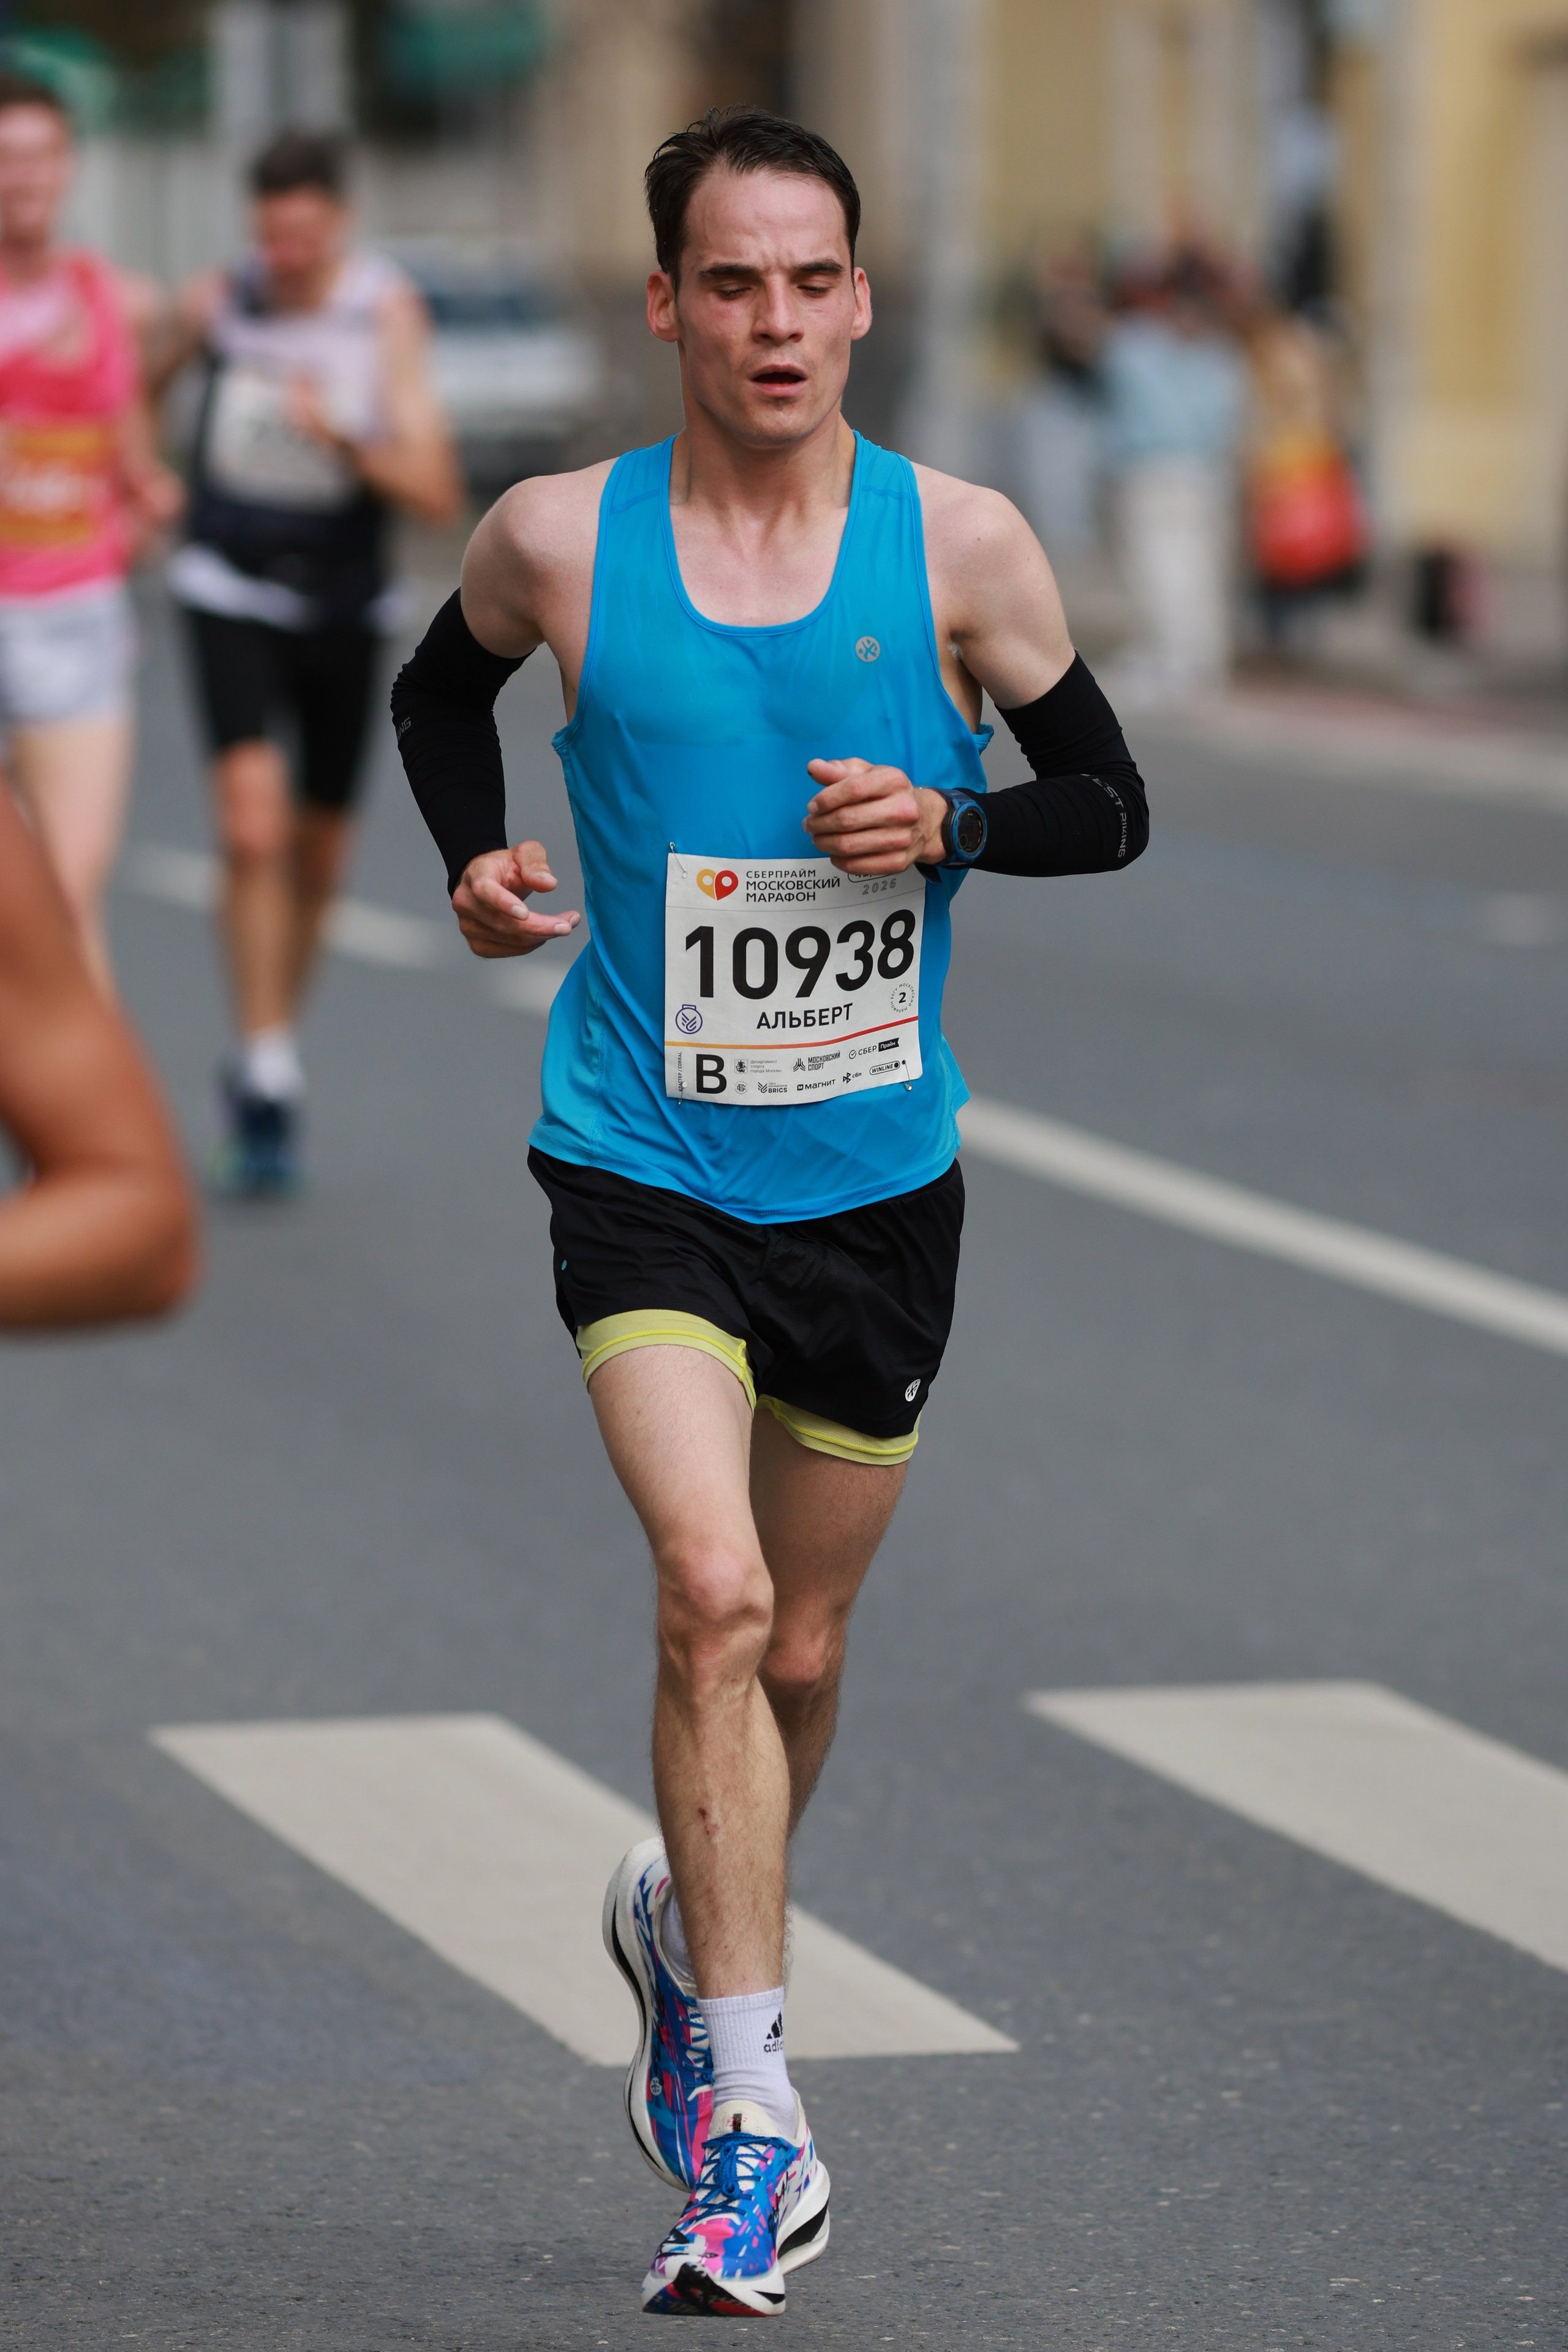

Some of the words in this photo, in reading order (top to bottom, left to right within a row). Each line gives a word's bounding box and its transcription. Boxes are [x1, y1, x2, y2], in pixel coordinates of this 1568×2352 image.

[746, 869, 816, 878] СБЕРПРАЙМ
[746, 876, 840, 891] МОСКОВСКИЙ
[862, 878, 897, 895] 2026
[746, 892, 816, 902] МАРАФОН
[685, 909, 916, 1000] 10938
[899, 992, 907, 1004] 2
[756, 1003, 853, 1029] АЛЬБЕРТ
[808, 1050, 840, 1064] МОСКОВСКИЙ
[858, 1046, 877, 1055] СБЕР
[808, 1063, 824, 1071] СПОРТ
[872, 1064, 894, 1074] WINLINE
[696, 1054, 727, 1095] B
